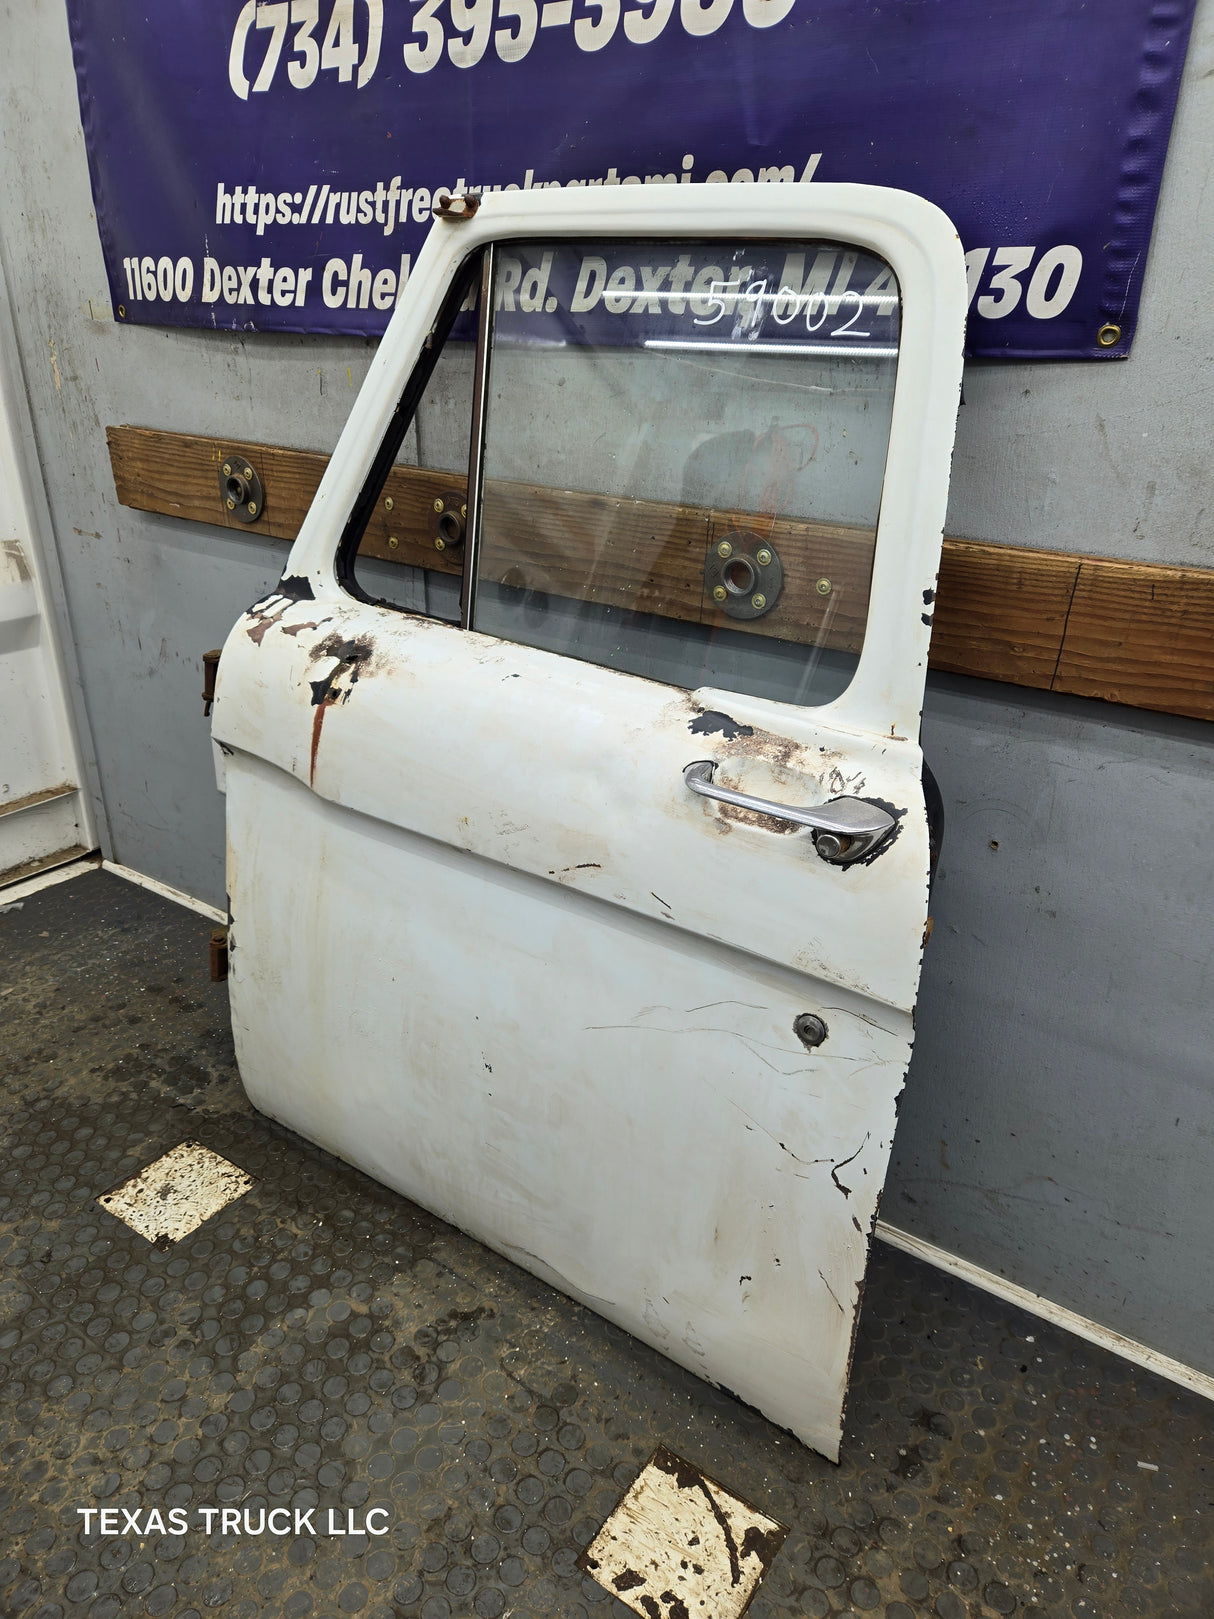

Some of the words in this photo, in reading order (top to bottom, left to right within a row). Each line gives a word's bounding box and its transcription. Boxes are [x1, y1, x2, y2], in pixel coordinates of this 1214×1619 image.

[228, 0, 384, 100] (734)
[123, 255, 194, 303] 11600
[202, 256, 313, 307] Dexter
[495, 251, 558, 314] Rd.
[771, 252, 859, 316] MI
[865, 244, 1083, 320] 4130
[693, 279, 871, 338] 59002
